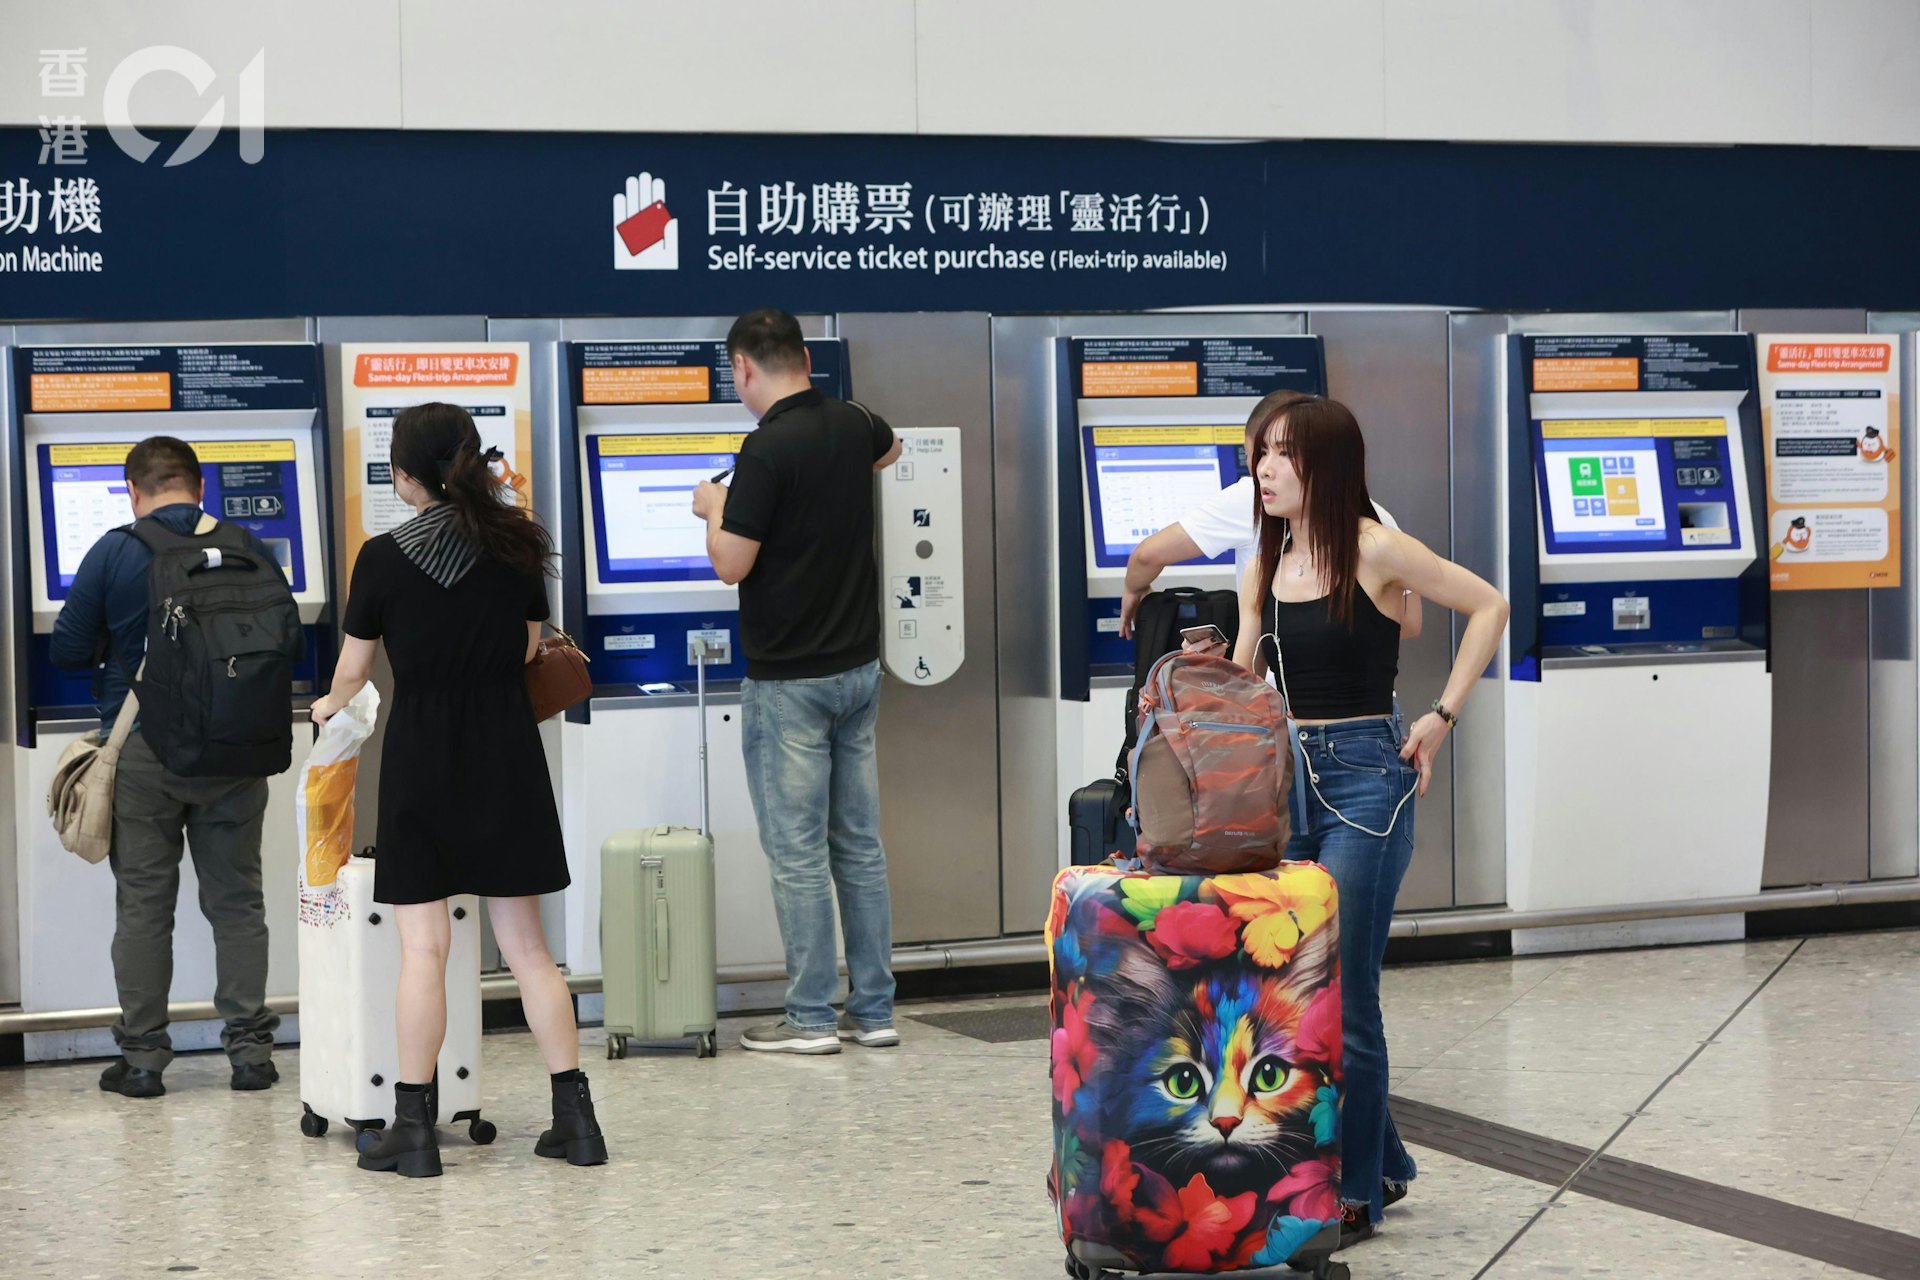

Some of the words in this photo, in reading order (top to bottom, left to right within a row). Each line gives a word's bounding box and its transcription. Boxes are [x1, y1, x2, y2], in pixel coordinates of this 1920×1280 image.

[0, 177, 103, 235] 助機
[22, 244, 103, 273] Machine
[708, 243, 852, 271] Self-service
[857, 244, 929, 271] ticket
[934, 243, 1045, 275] purchase
[1049, 249, 1139, 273] (Flexi-trip
[1142, 249, 1228, 272] available)
[367, 372, 412, 384] Same-day
[412, 372, 451, 383] Flexi-trip
[452, 372, 508, 383] Arrangement
